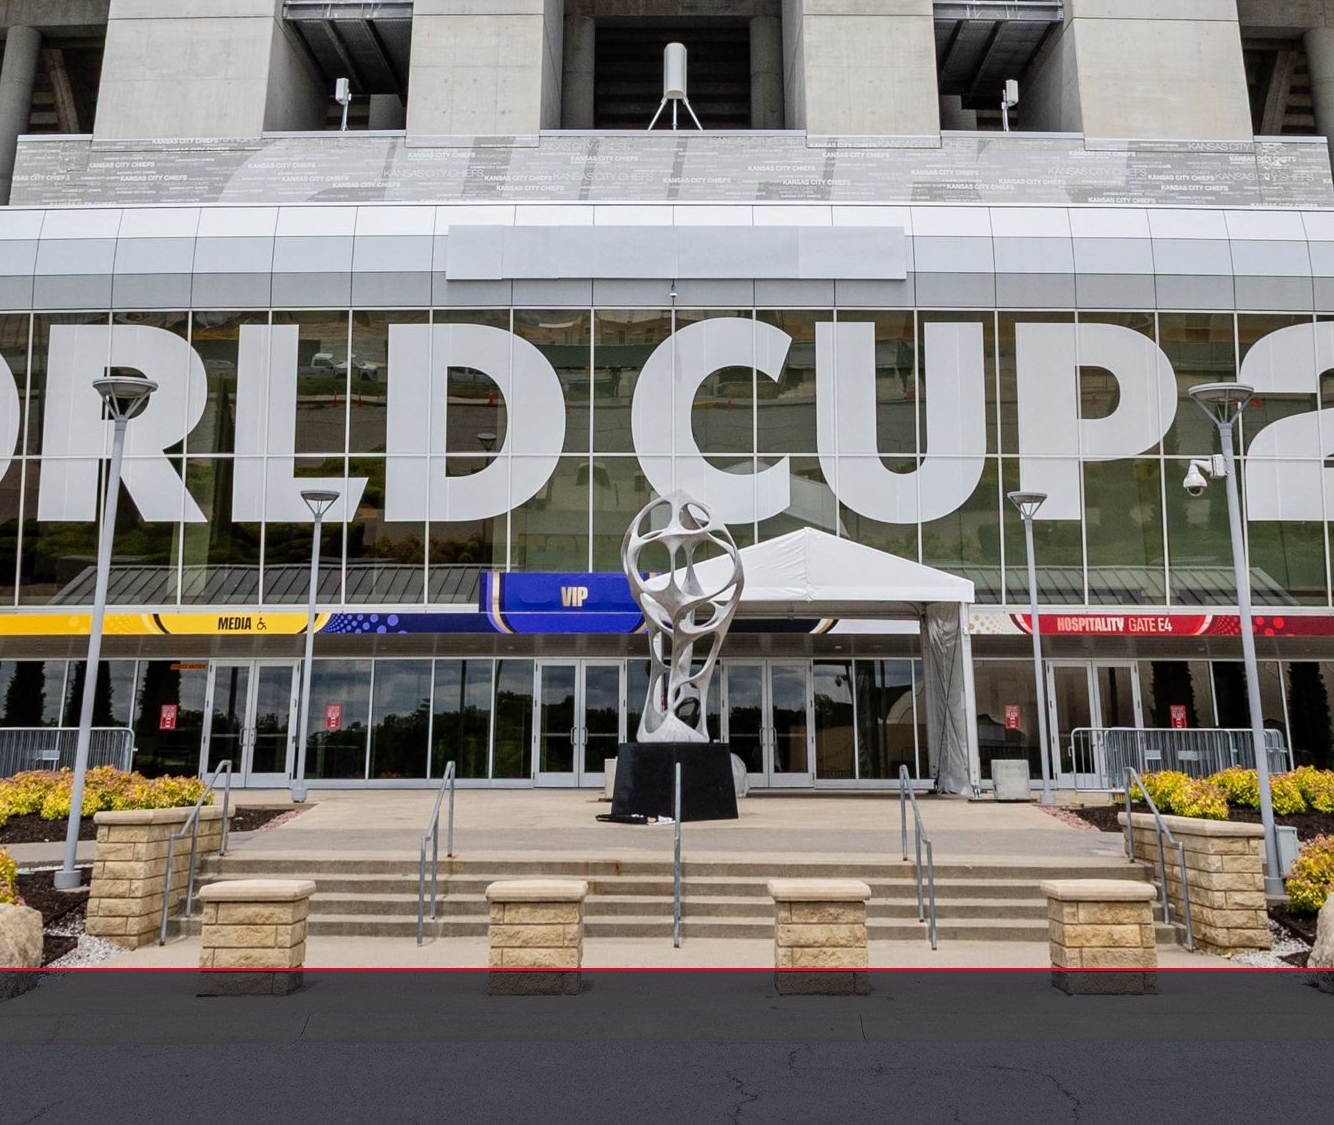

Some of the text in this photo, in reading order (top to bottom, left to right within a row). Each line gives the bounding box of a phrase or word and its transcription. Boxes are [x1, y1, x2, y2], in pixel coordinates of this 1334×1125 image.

[631, 317, 1177, 524] CUP
[560, 586, 588, 607] VIP
[218, 617, 252, 630] MEDIA
[1057, 617, 1172, 632] HOSPITALITY GATE E4
